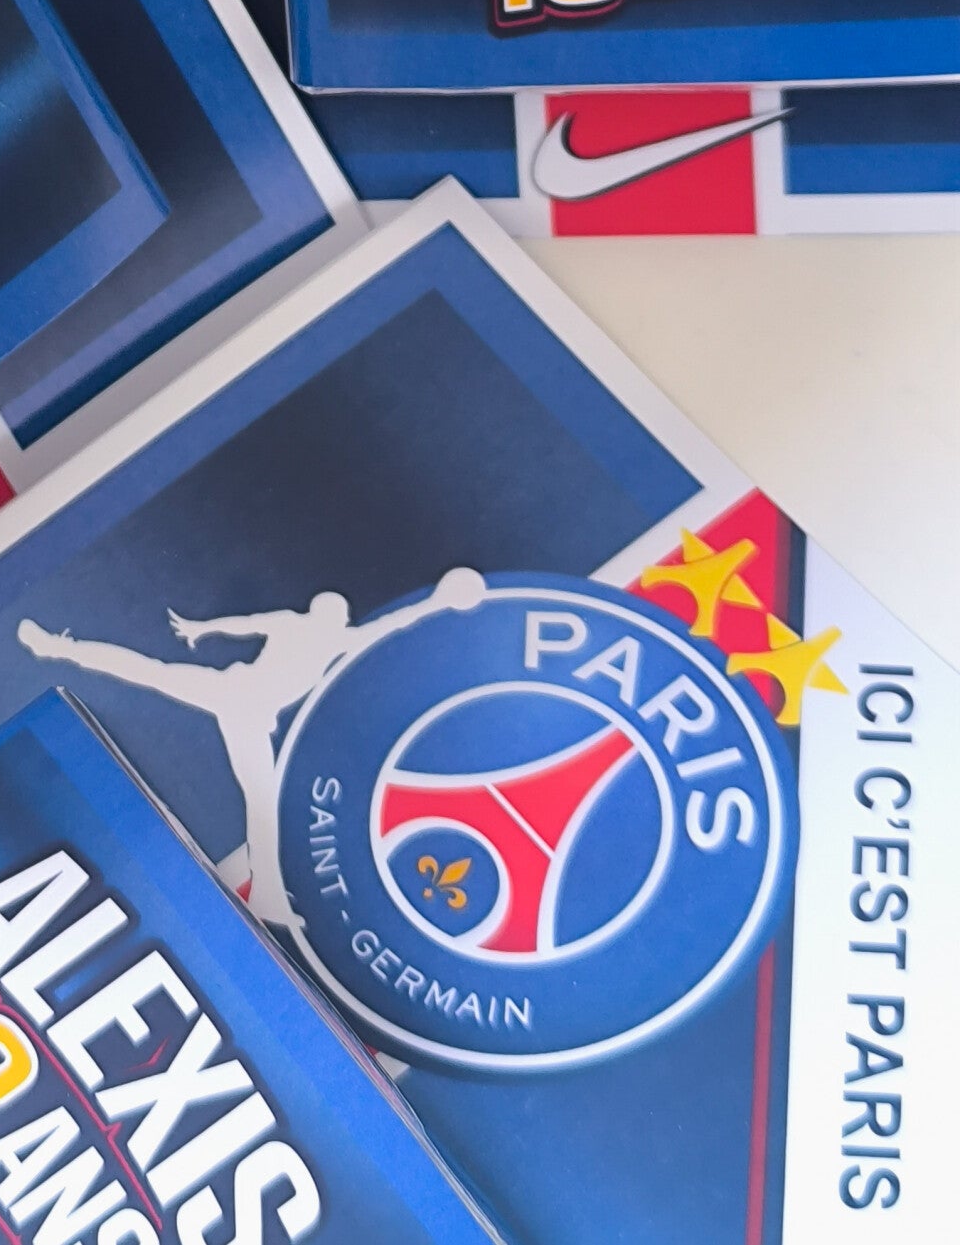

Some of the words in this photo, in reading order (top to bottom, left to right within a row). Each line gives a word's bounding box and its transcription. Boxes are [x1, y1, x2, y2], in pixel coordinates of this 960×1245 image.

[523, 609, 756, 852] PARIS
[857, 662, 915, 744] ICI
[309, 775, 351, 898] SAINT
[351, 929, 535, 1030] GERMAIN
[838, 993, 907, 1212] PARIS
